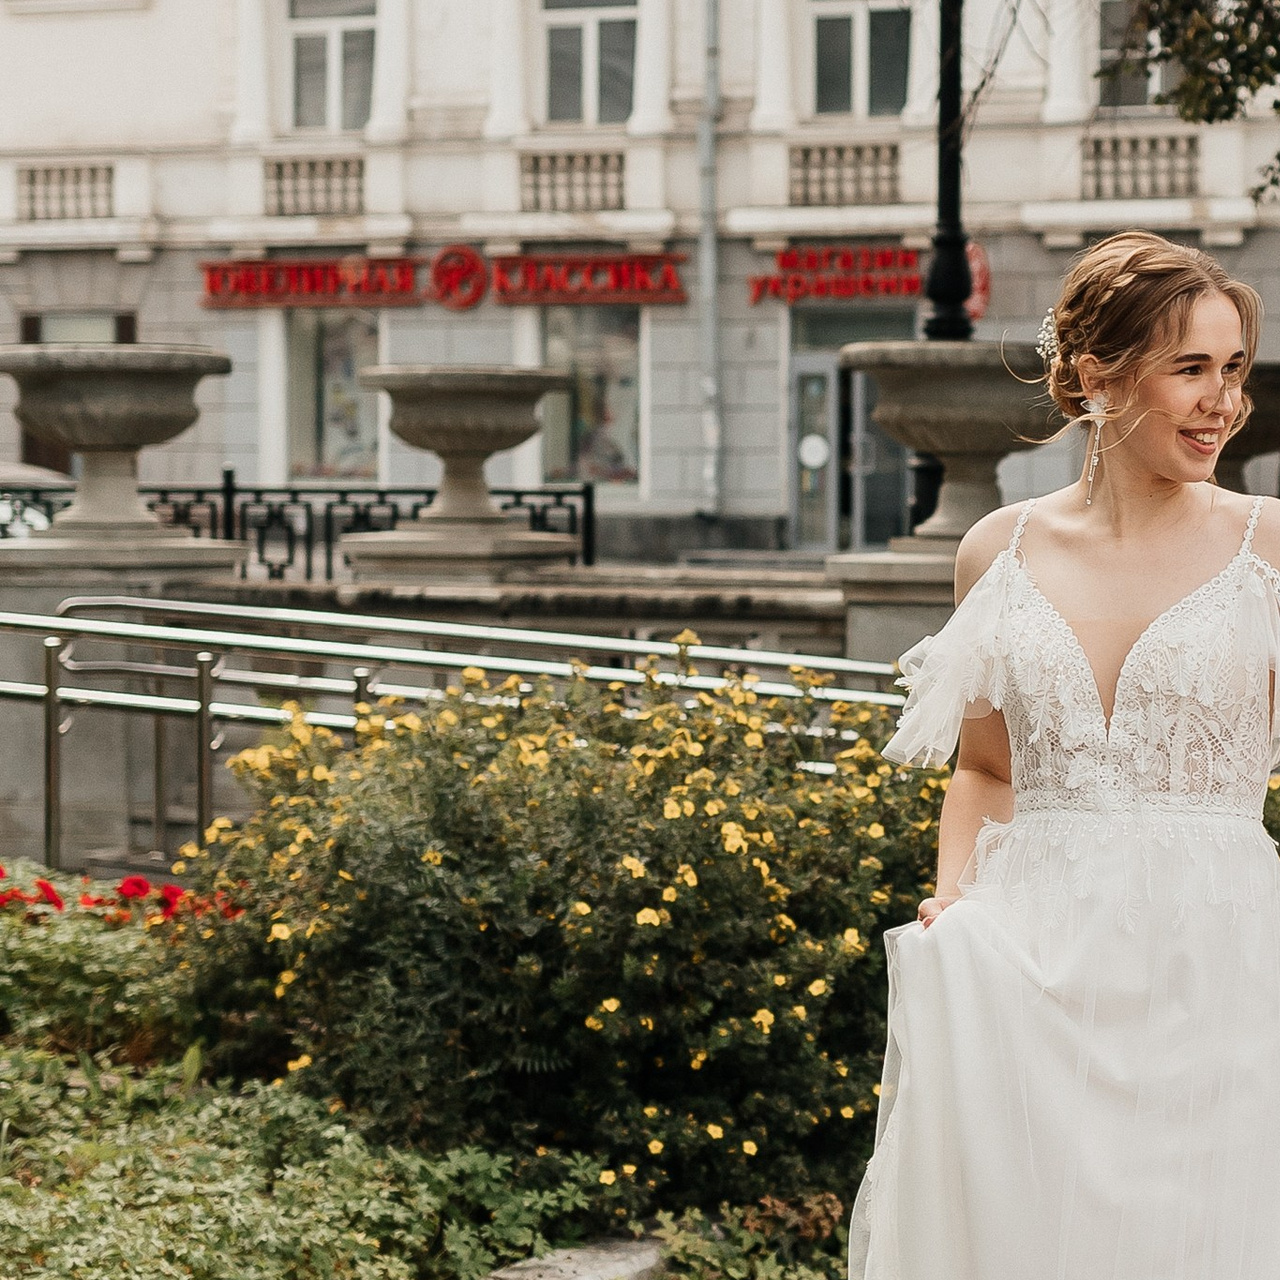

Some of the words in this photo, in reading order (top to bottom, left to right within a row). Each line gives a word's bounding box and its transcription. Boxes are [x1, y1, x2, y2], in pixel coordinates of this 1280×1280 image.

[205, 264, 415, 294] ЮВЕЛИРНАЯ
[492, 262, 681, 291] КЛАССИКА
[748, 274, 922, 305] украшени
